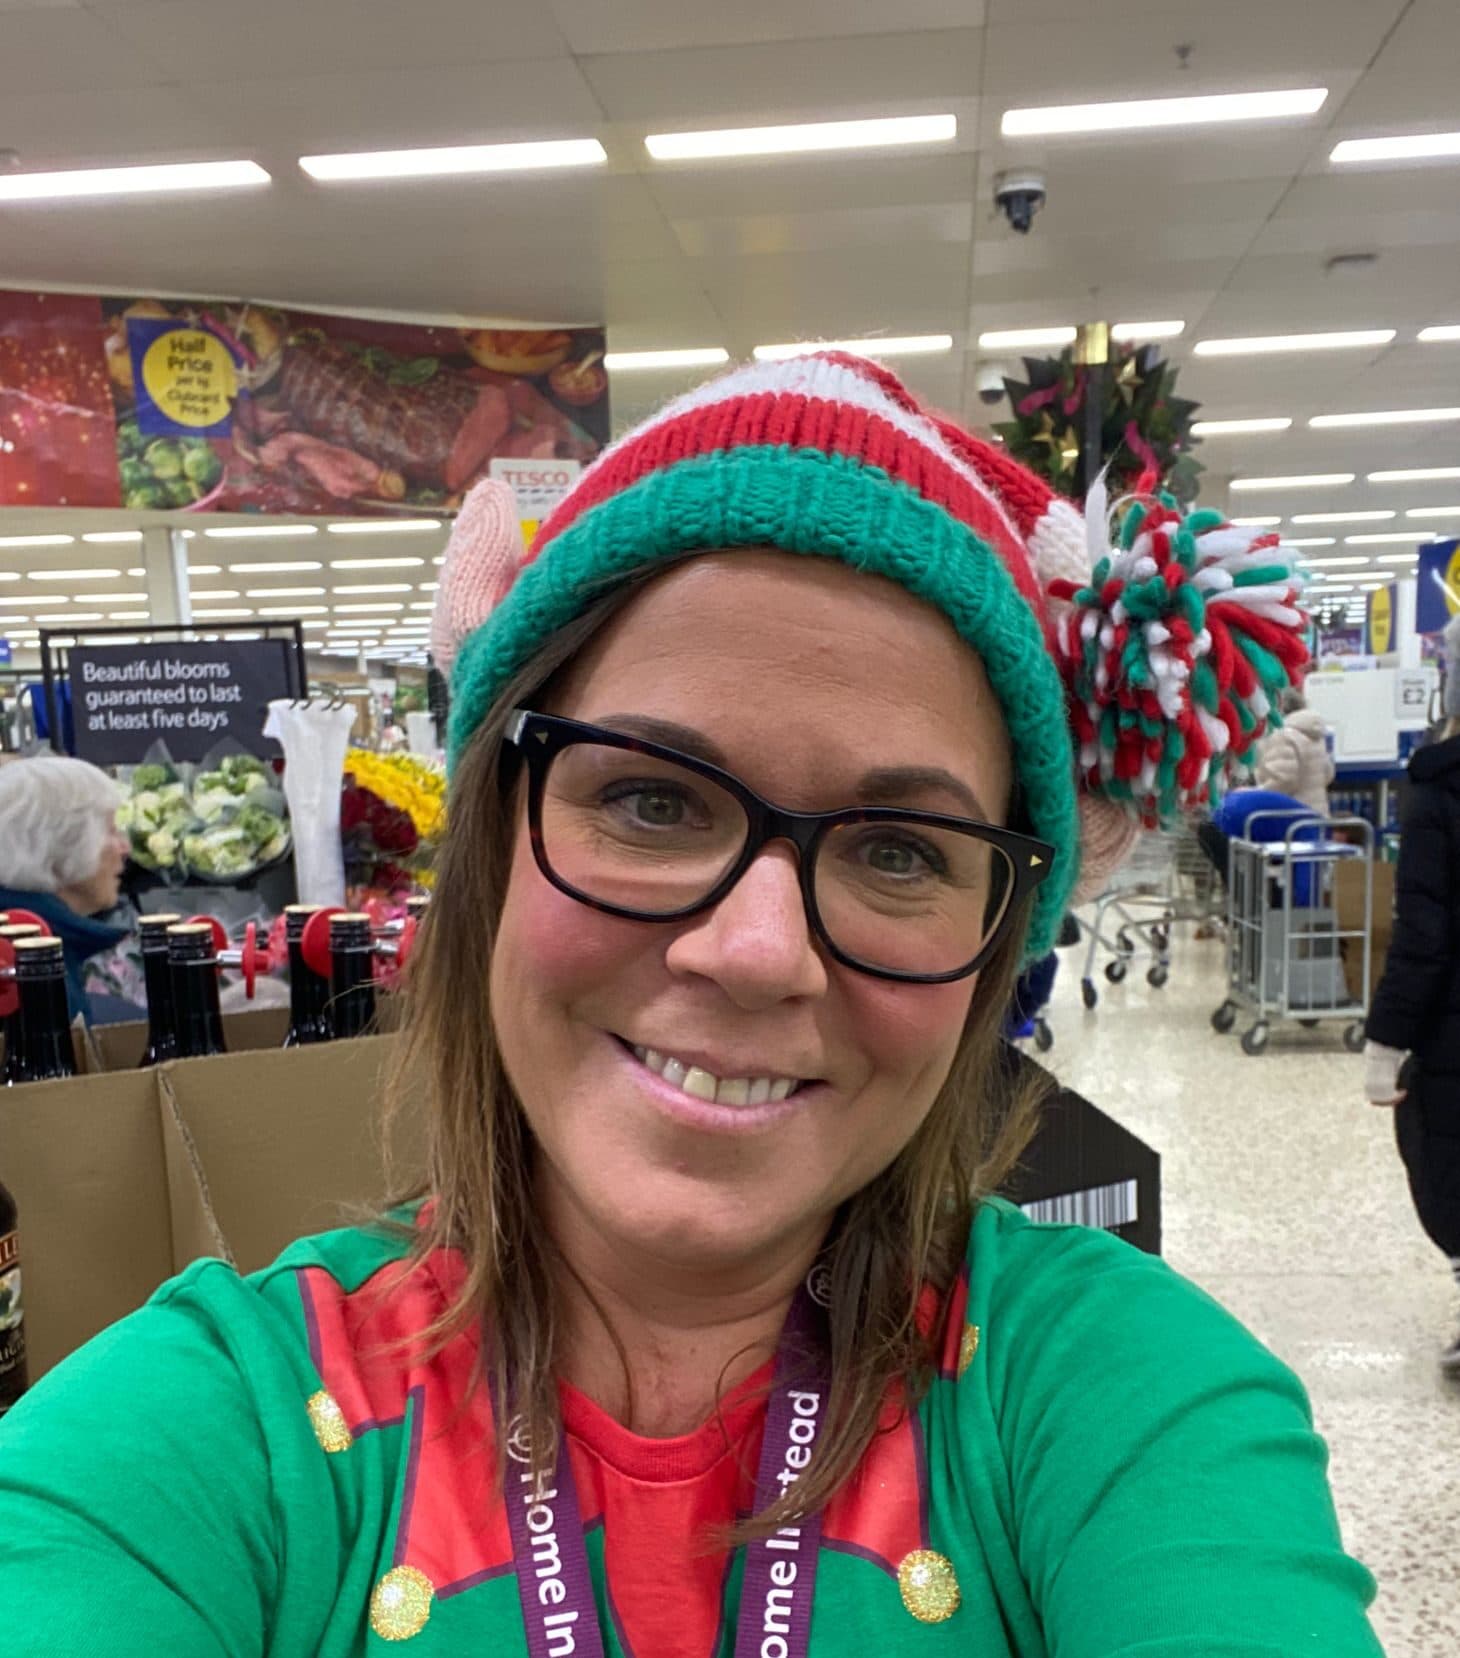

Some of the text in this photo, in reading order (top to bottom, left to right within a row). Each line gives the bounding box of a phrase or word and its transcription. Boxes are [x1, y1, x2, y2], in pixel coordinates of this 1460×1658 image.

[170, 337, 206, 353] Half
[167, 356, 213, 372] Price
[180, 404, 210, 416] Price
[501, 470, 569, 486] TESCO
[83, 659, 230, 683] Beautiful blooms
[85, 683, 242, 711] guaranteed to last
[88, 707, 229, 732] at least five days
[765, 1390, 821, 1550] Itead
[520, 1470, 567, 1605] Home
